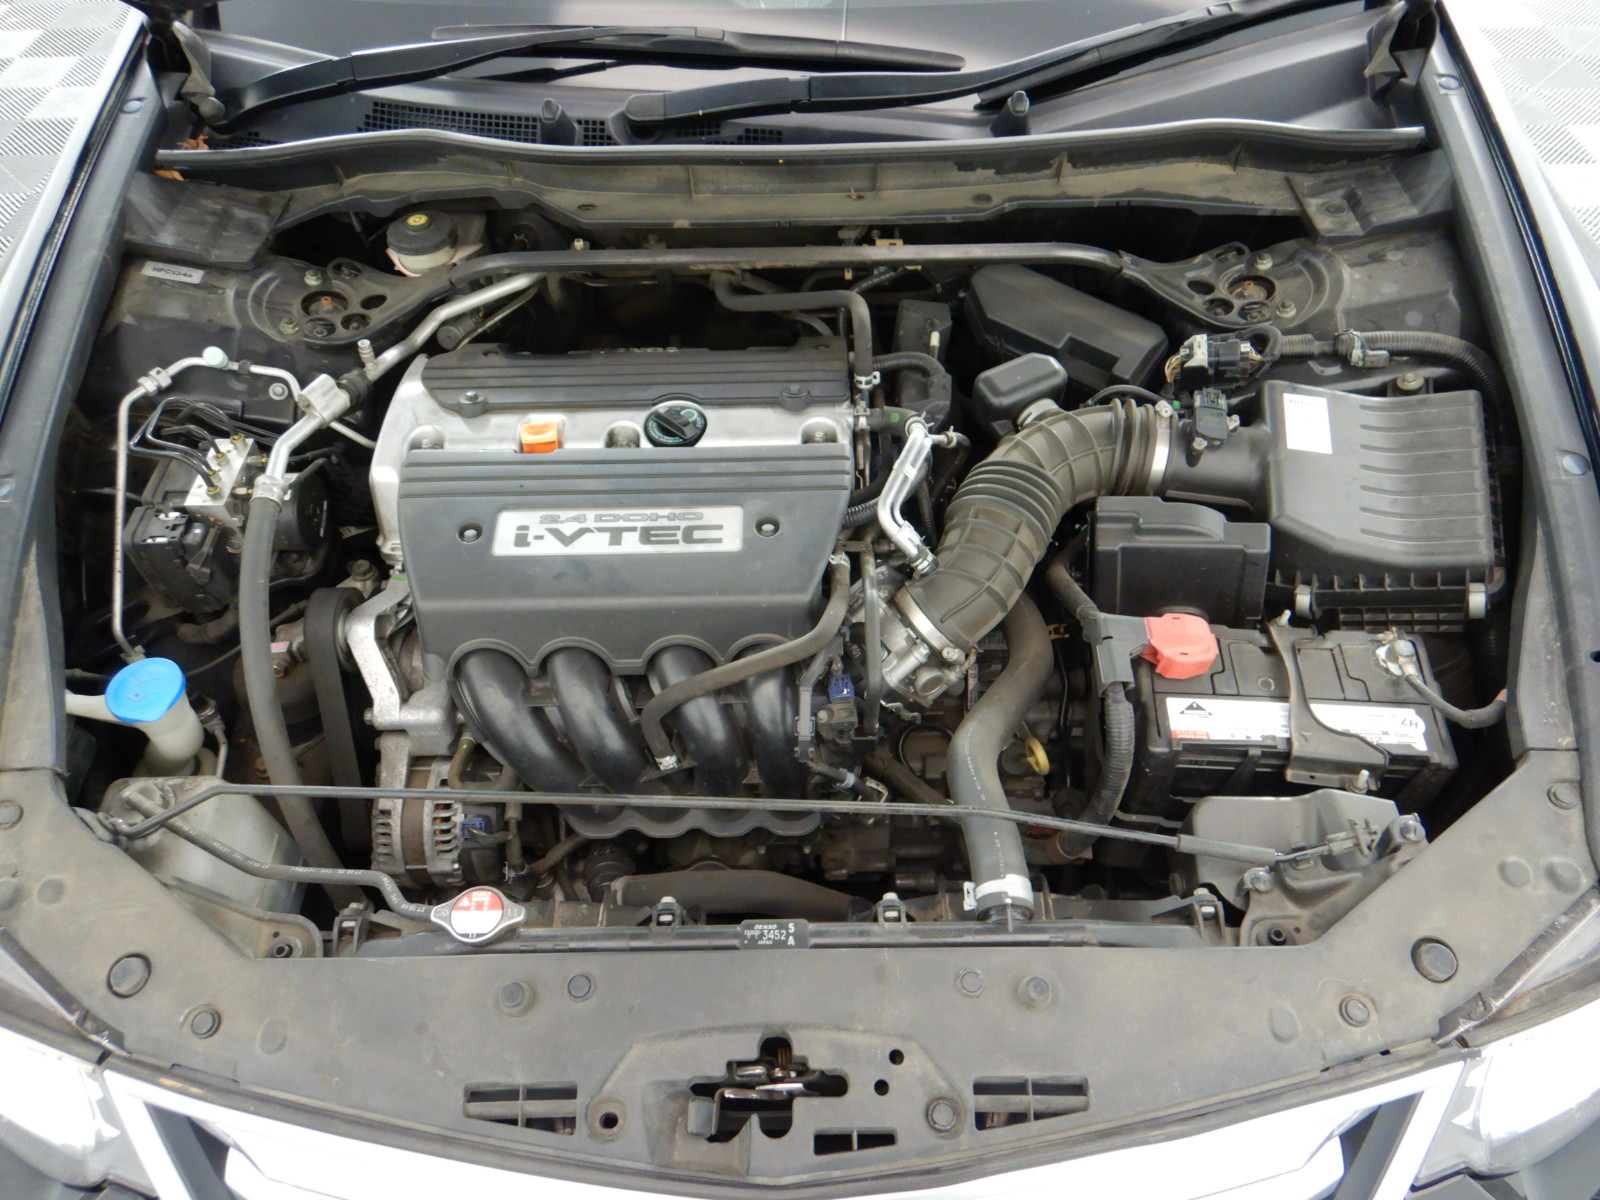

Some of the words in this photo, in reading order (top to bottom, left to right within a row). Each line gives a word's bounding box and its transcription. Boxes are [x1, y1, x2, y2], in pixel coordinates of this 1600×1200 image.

[539, 513, 587, 525] 2.4
[594, 511, 704, 523] DOHC
[513, 524, 724, 548] i-VTEC
[788, 922, 795, 933] 5
[762, 930, 786, 940] 3452
[788, 936, 795, 946] A
